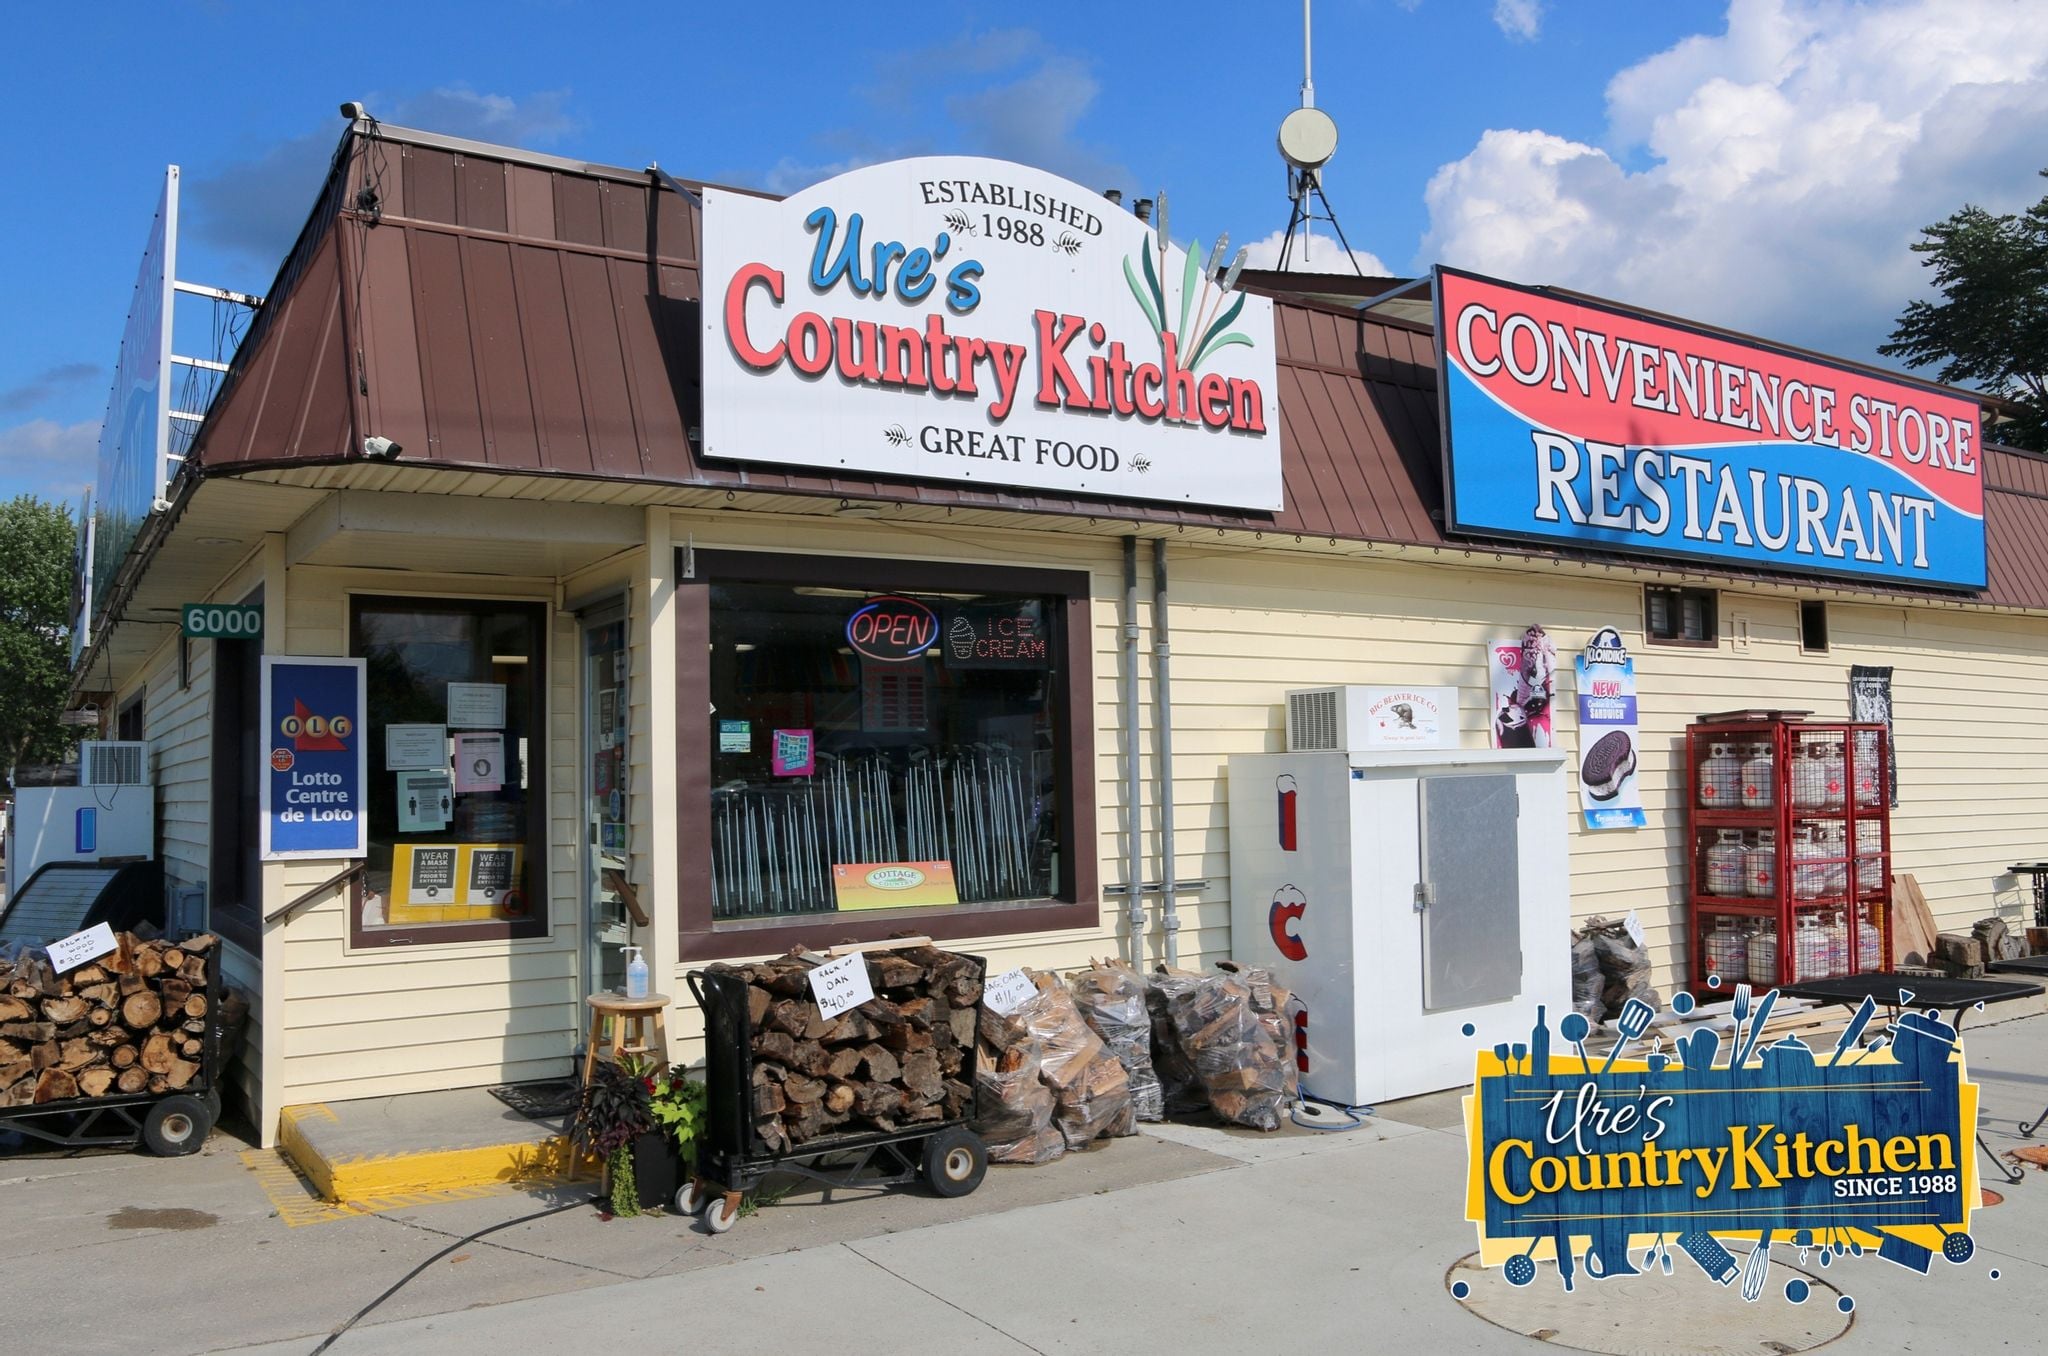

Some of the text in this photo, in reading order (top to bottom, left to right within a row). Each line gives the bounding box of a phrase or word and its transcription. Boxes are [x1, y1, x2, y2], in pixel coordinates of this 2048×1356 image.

[919, 180, 1103, 237] ESTABLISHED
[981, 213, 1045, 247] 1988
[806, 206, 984, 311] Ure's
[725, 262, 1267, 434] Country Kitchen
[1456, 302, 1977, 475] CONVENIENCE STORE
[919, 425, 1120, 473] GREAT FOOD
[1531, 431, 1935, 568] RESTAURANT
[187, 608, 261, 634] 6000
[852, 613, 930, 645] OPEN
[988, 617, 1034, 637] ICE
[976, 639, 1045, 658] CREAM
[1585, 647, 1626, 669] KLONDIKE
[1592, 682, 1620, 697] NEW!
[1369, 703, 1383, 716] BIG
[1383, 693, 1413, 705] BEAVER
[1413, 694, 1426, 705] ICE
[1590, 708, 1624, 720] SANDWICH
[286, 718, 346, 735] OLG
[292, 771, 342, 786] Lotto
[286, 789, 348, 804] Centre
[280, 807, 354, 823] de Loto
[421, 852, 449, 860] WEAR
[480, 853, 506, 861] WEAR
[873, 870, 917, 880] COTTAGE
[819, 965, 840, 977] RACK
[1003, 970, 1022, 984] OAK
[826, 975, 849, 990] OAK
